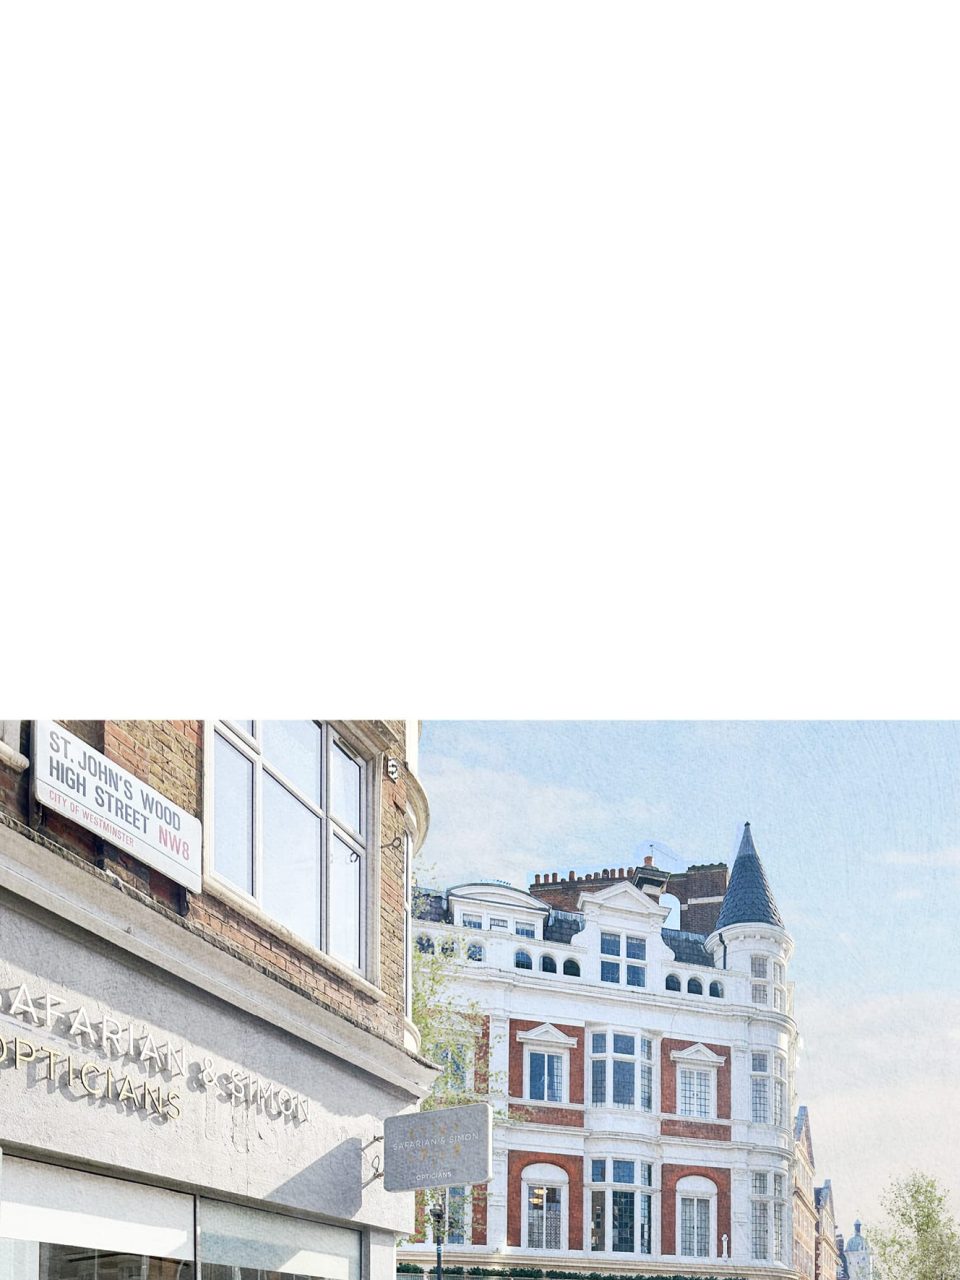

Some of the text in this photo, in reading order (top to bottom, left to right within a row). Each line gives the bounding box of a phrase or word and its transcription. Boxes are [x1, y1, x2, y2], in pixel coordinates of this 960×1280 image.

[49, 790, 135, 847] CITY OF WESTMINSTER
[50, 730, 181, 832] ST. JOHN'S WOOD
[50, 755, 190, 861] HIGH STREET NW8
[0, 983, 309, 1121] AFARIAN & SIMON
[0, 1034, 181, 1120] PTICIANS
[392, 1138, 437, 1151] SAFARIAN
[449, 1132, 479, 1144] SIMON
[415, 1171, 452, 1181] OPTICIANS
